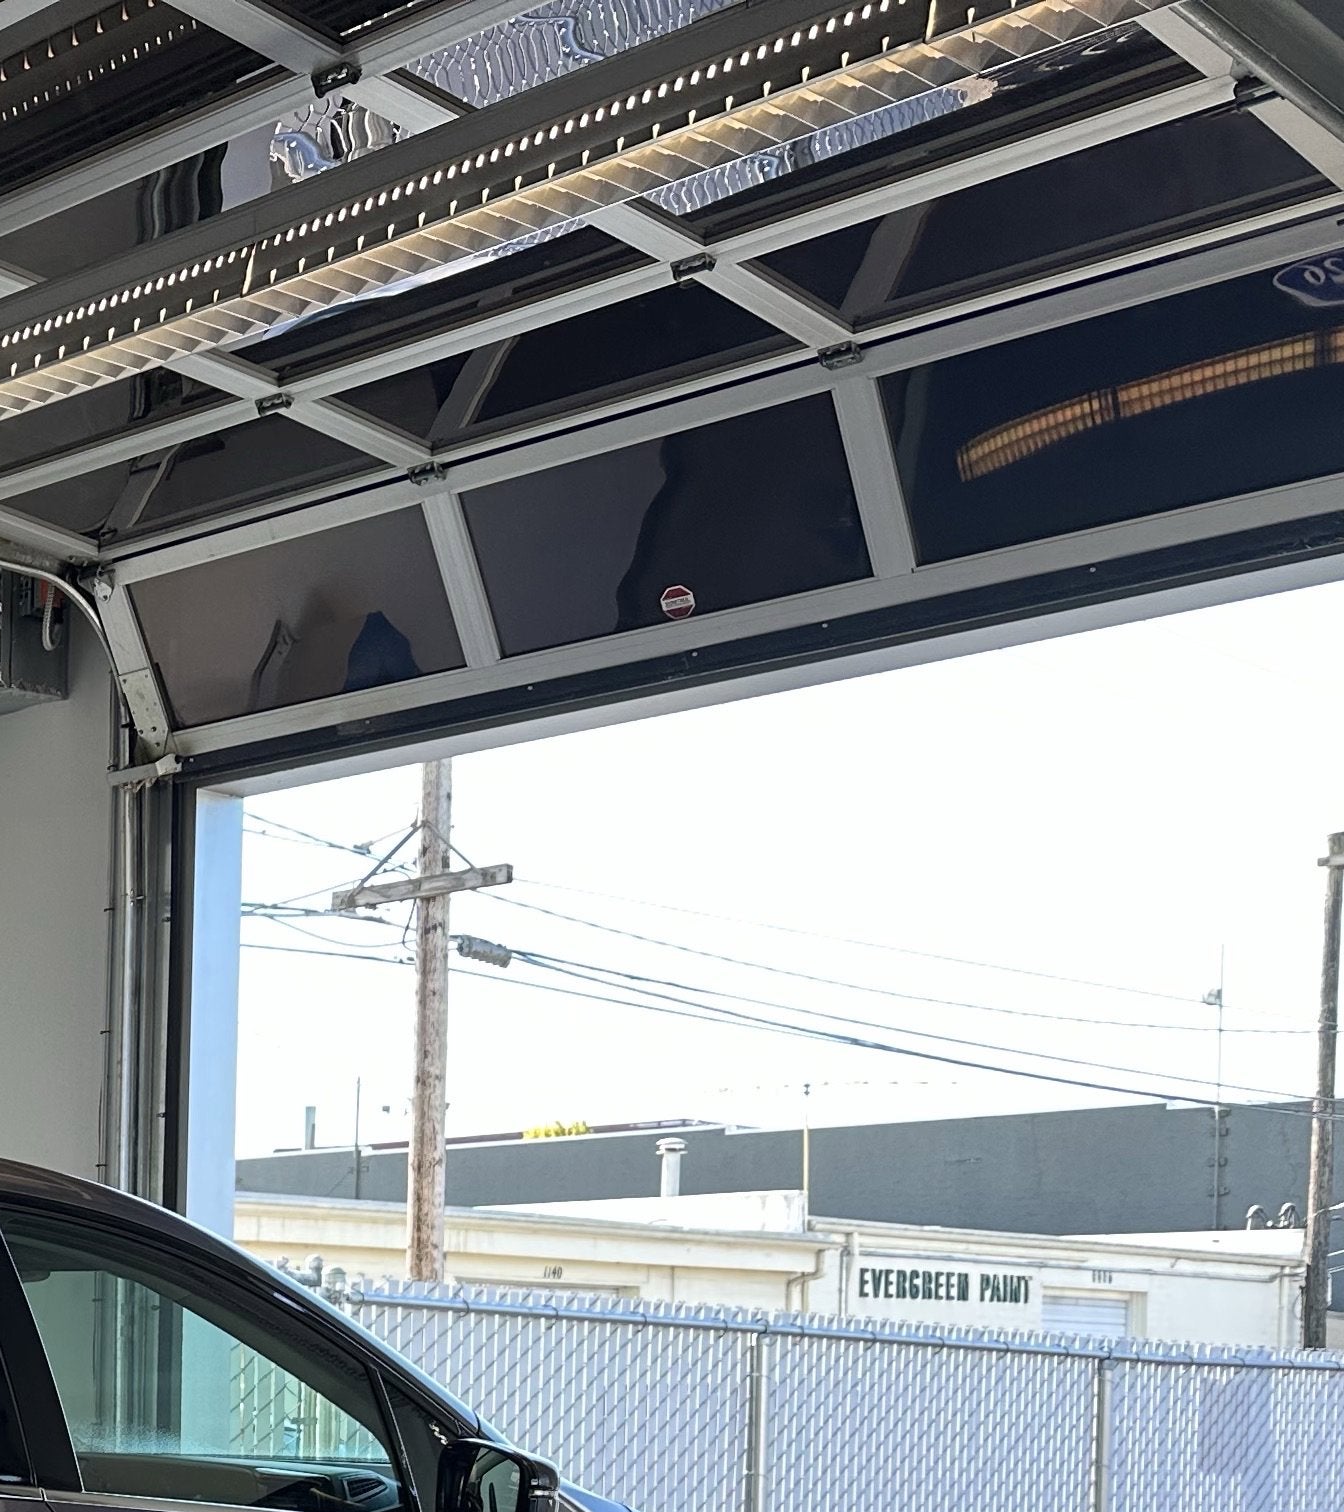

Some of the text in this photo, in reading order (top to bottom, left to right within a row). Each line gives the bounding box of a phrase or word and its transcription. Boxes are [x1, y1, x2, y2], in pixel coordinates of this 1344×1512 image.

[543, 1264, 563, 1280] 1140
[858, 1267, 1033, 1304] EVERGREEN PAINT
